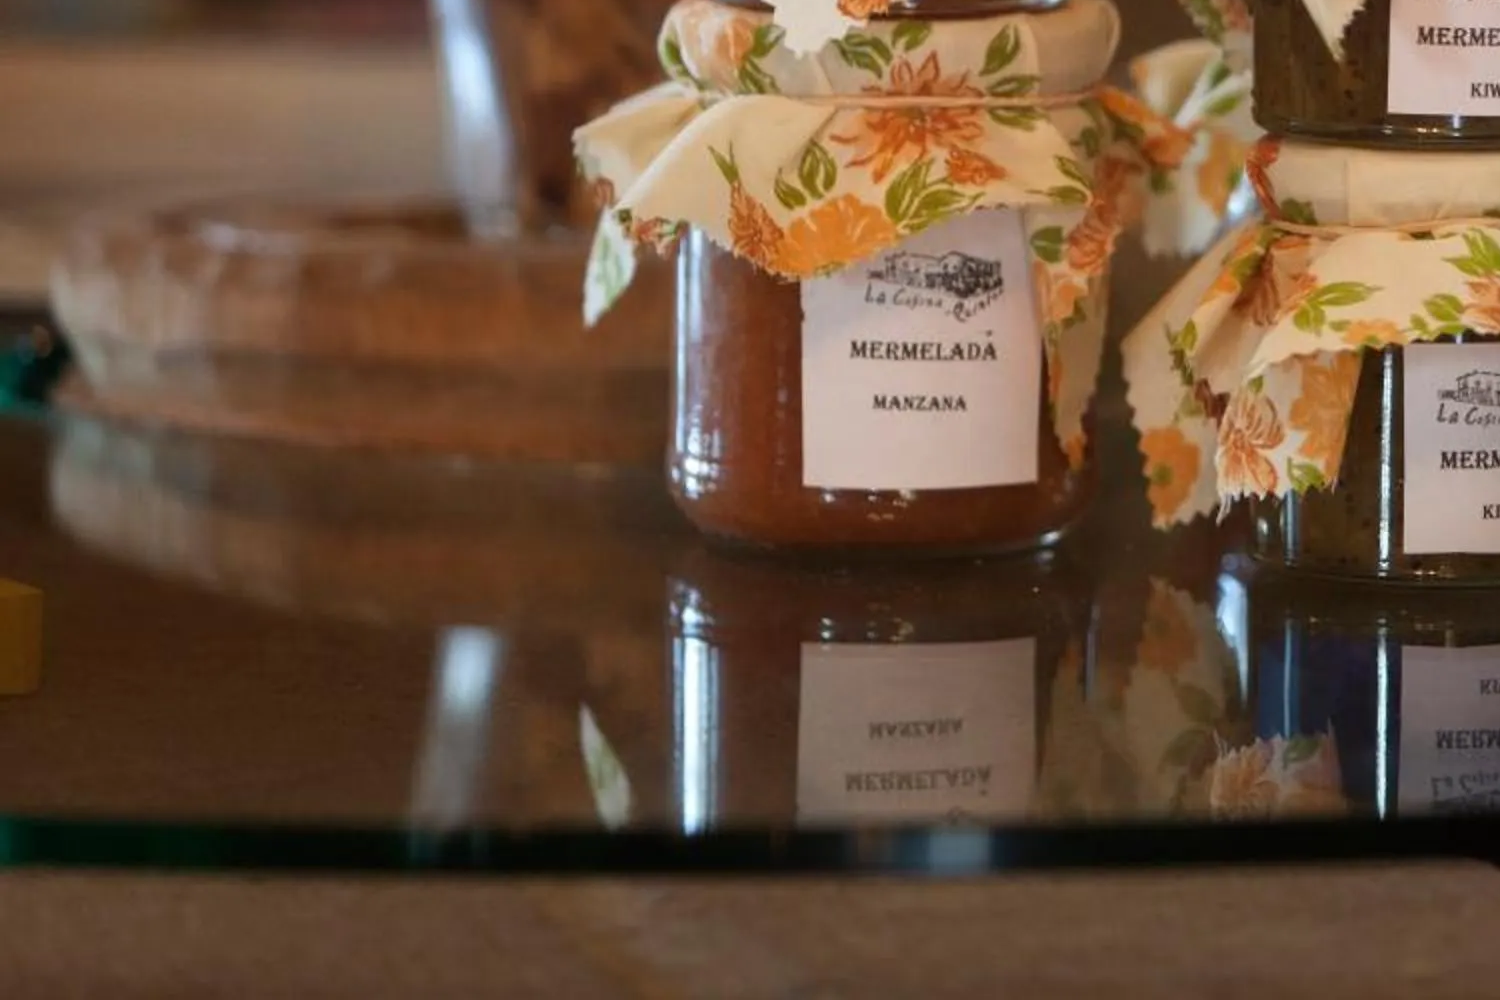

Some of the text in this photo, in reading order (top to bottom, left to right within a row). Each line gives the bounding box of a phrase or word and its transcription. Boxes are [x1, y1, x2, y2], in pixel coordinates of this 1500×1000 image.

[864, 283, 886, 305] La
[849, 340, 998, 361] MERMELADA
[872, 394, 968, 412] MANZANA
[1437, 404, 1458, 424] La
